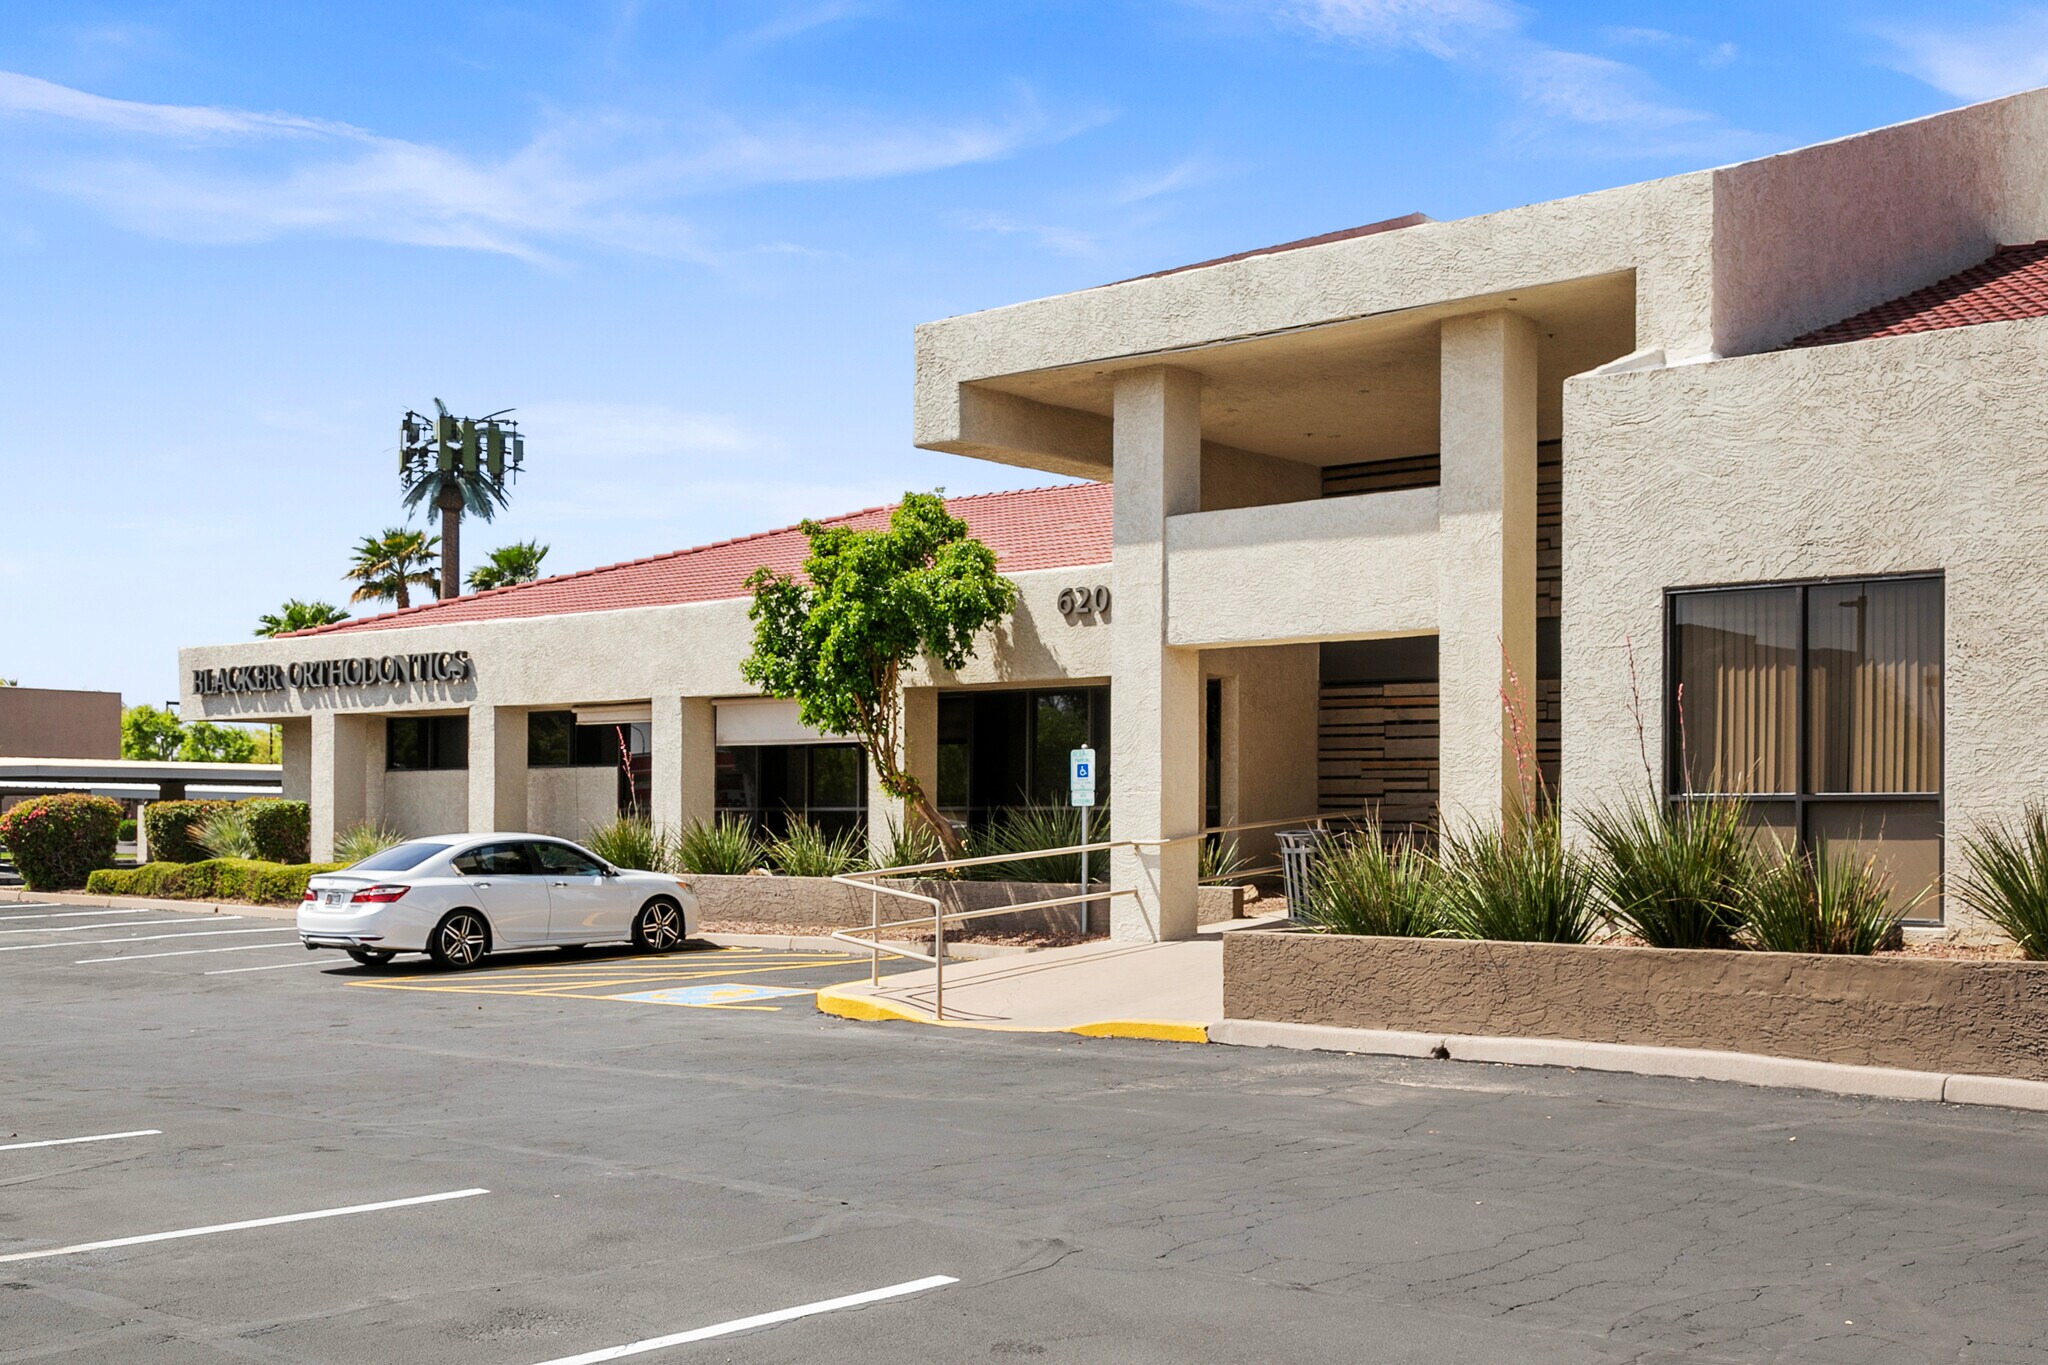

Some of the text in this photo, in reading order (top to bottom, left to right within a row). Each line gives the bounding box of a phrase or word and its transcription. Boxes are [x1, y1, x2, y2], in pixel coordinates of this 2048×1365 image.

[1057, 585, 1111, 615] 620
[192, 650, 468, 695] BLACKER ORTHODONTICS
